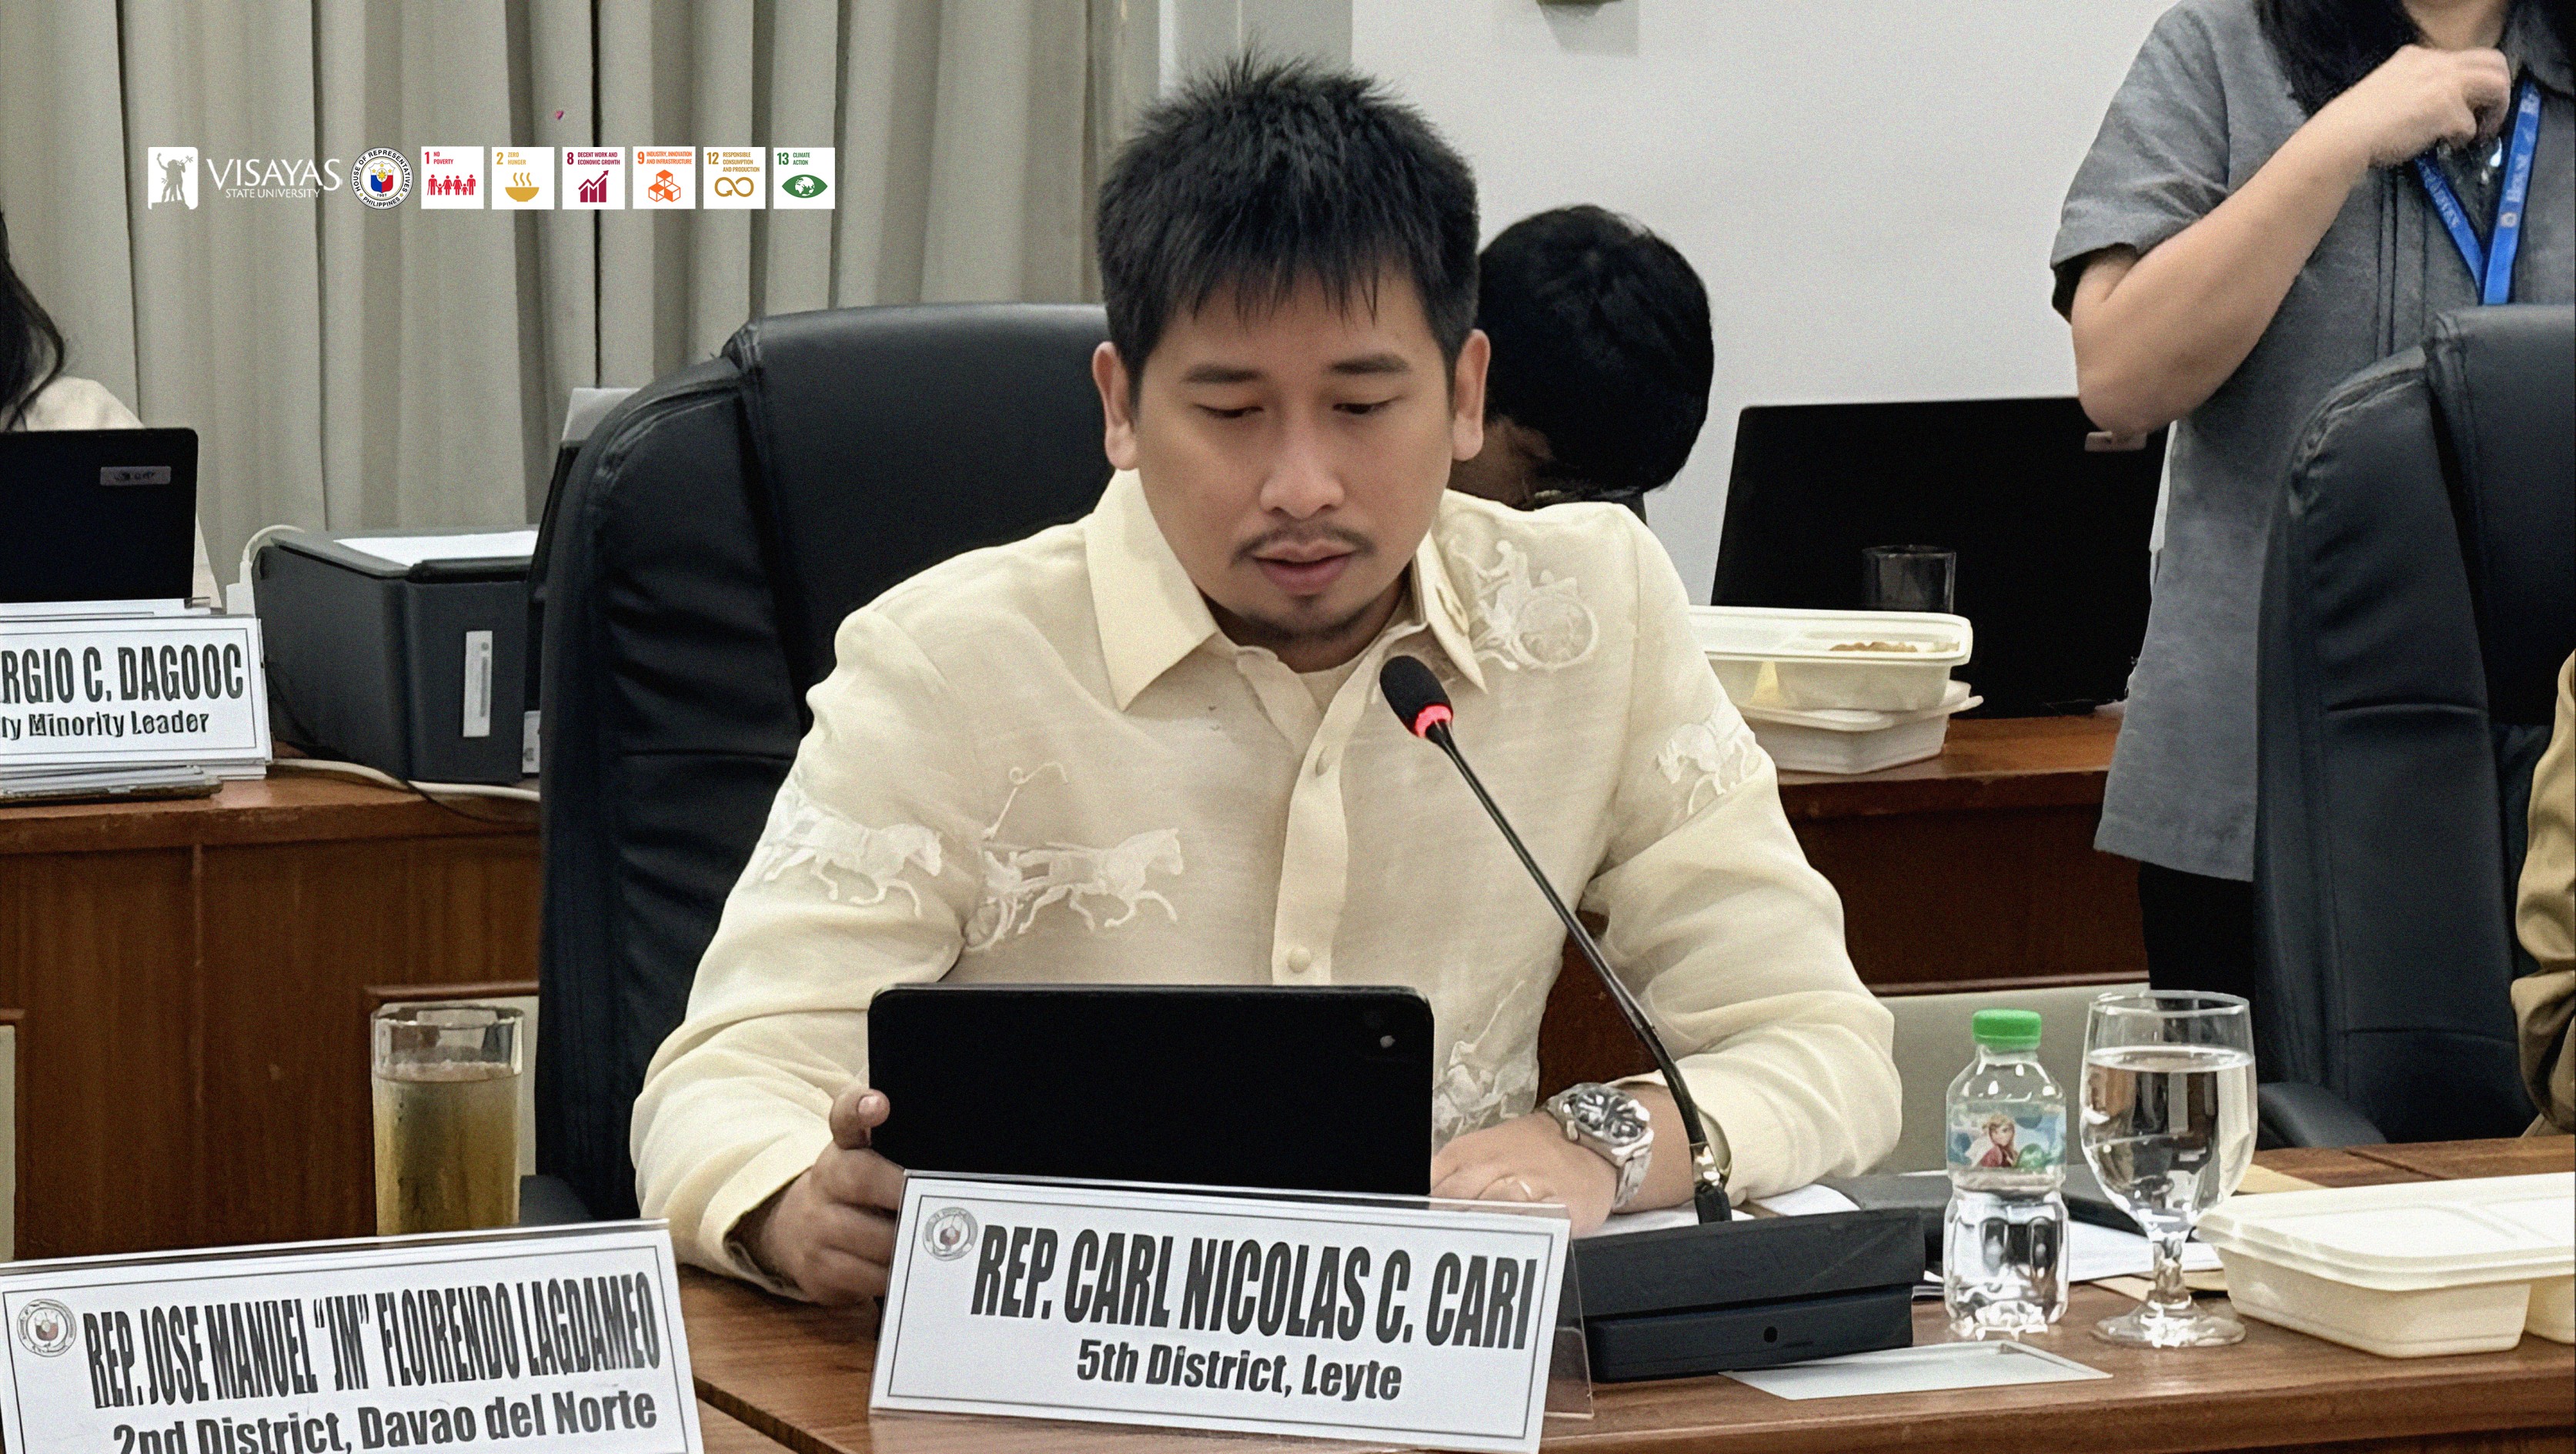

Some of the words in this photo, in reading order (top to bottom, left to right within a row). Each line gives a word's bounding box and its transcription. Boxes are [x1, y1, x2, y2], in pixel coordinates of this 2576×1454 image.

[82, 646, 112, 702] C.
[117, 643, 243, 701] DAGOOC
[28, 711, 125, 737] Minority
[131, 710, 209, 735] Leader
[970, 1224, 1059, 1320] REP.
[1064, 1228, 1174, 1329] CARL
[1179, 1236, 1372, 1342] NICOLAS
[1375, 1248, 1414, 1345] C.
[1425, 1252, 1539, 1350] CARI
[82, 1310, 145, 1409] REP.
[139, 1305, 210, 1406] JOSE
[204, 1299, 318, 1400] MANUEL
[375, 1282, 520, 1387] FLOIRENDO
[516, 1271, 661, 1378] LAGDAMEO
[1077, 1338, 1139, 1383] 5th
[1145, 1343, 1292, 1399] District,
[1301, 1353, 1403, 1402] Leyte
[113, 1421, 189, 1454] 2nd
[195, 1412, 352, 1454] District,
[357, 1406, 477, 1449] Davao
[484, 1392, 547, 1441] del
[552, 1389, 657, 1435] Norte
